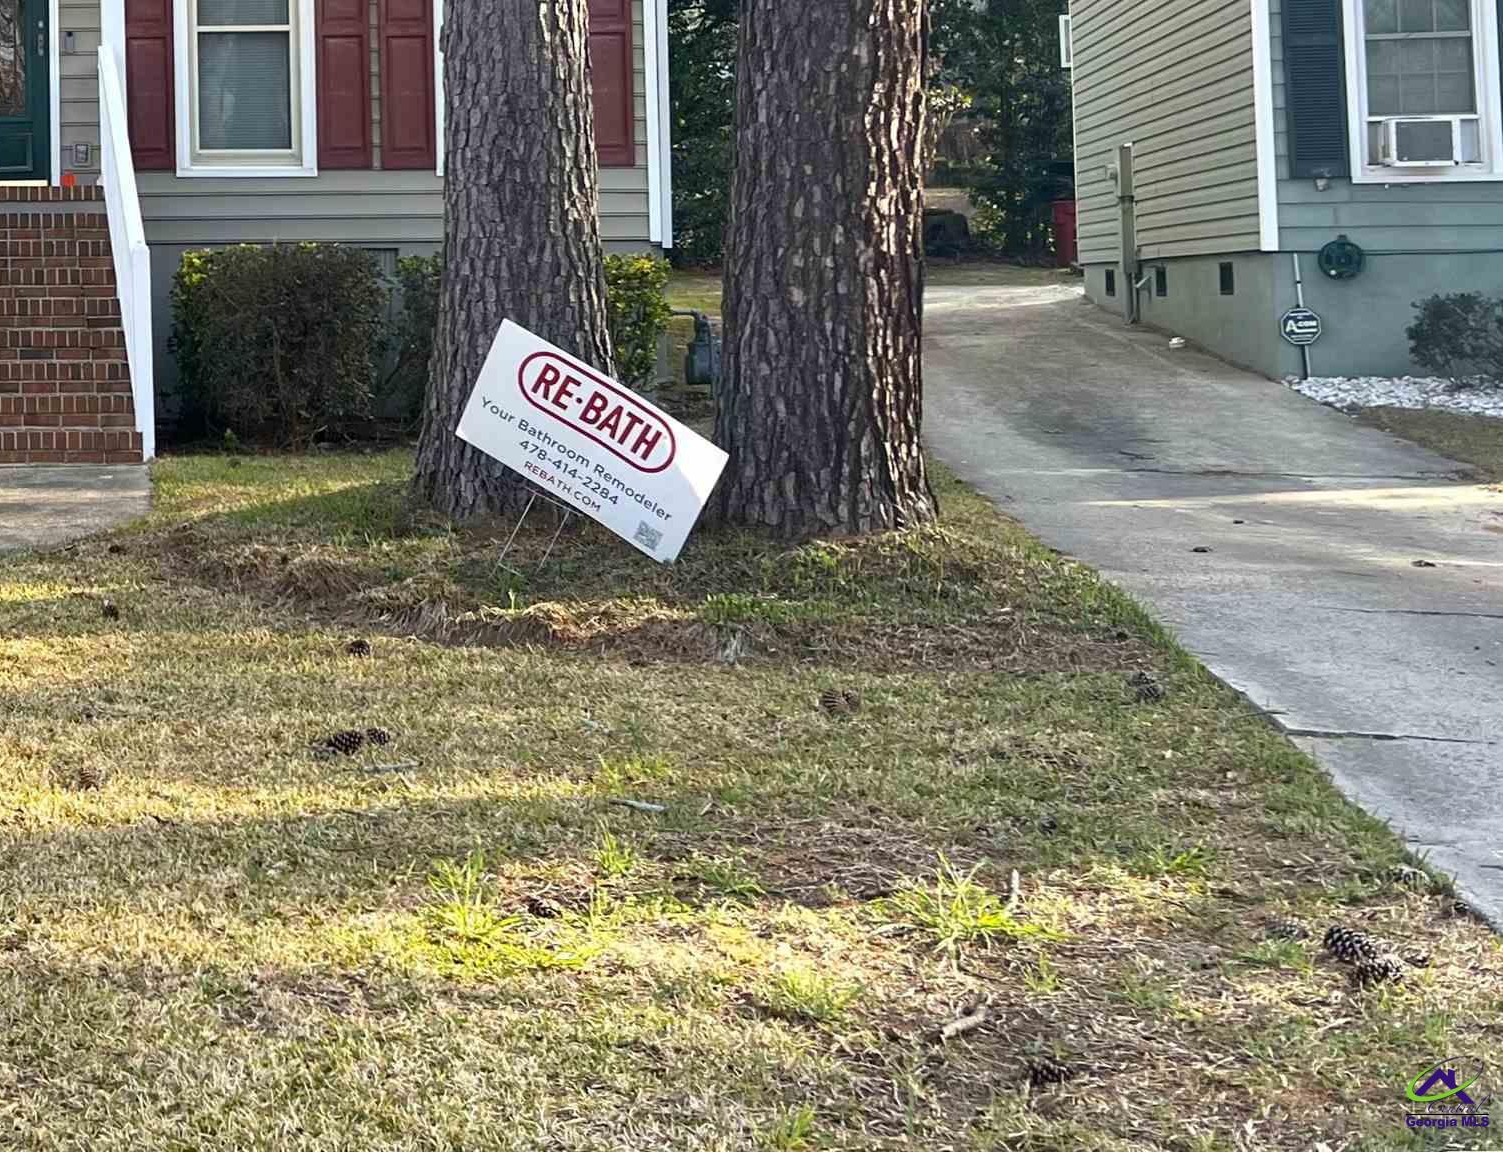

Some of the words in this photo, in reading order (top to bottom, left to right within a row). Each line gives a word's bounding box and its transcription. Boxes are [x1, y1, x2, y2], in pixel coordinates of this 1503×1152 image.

[482, 397, 515, 424] Your
[517, 419, 590, 468] Bathroom
[593, 465, 672, 521] Remodeler
[519, 440, 619, 505] 478-414-2284
[524, 461, 601, 512] REBATH.COM
